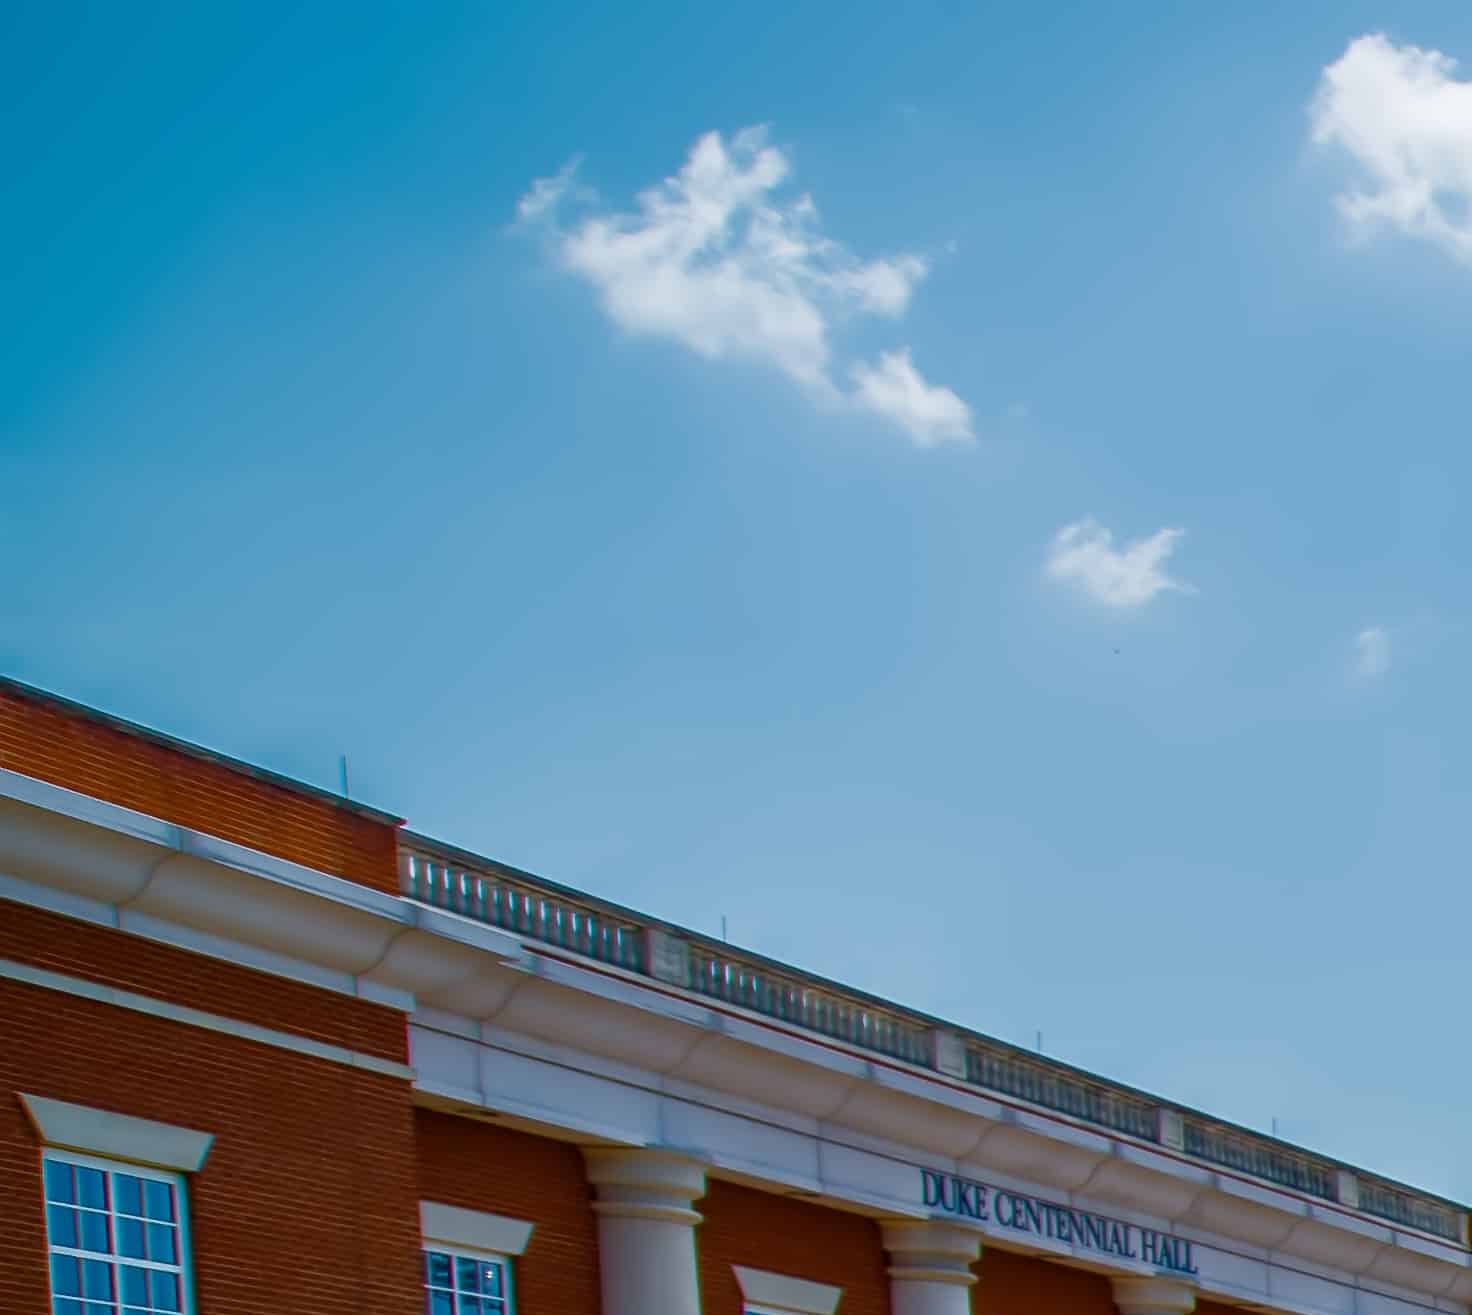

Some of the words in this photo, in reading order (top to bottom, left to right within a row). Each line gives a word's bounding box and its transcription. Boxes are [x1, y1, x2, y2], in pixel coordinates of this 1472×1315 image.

[921, 1168, 988, 1220] DUKE
[993, 1192, 1136, 1258] CENTENNIAL
[1142, 1229, 1198, 1274] HALL
